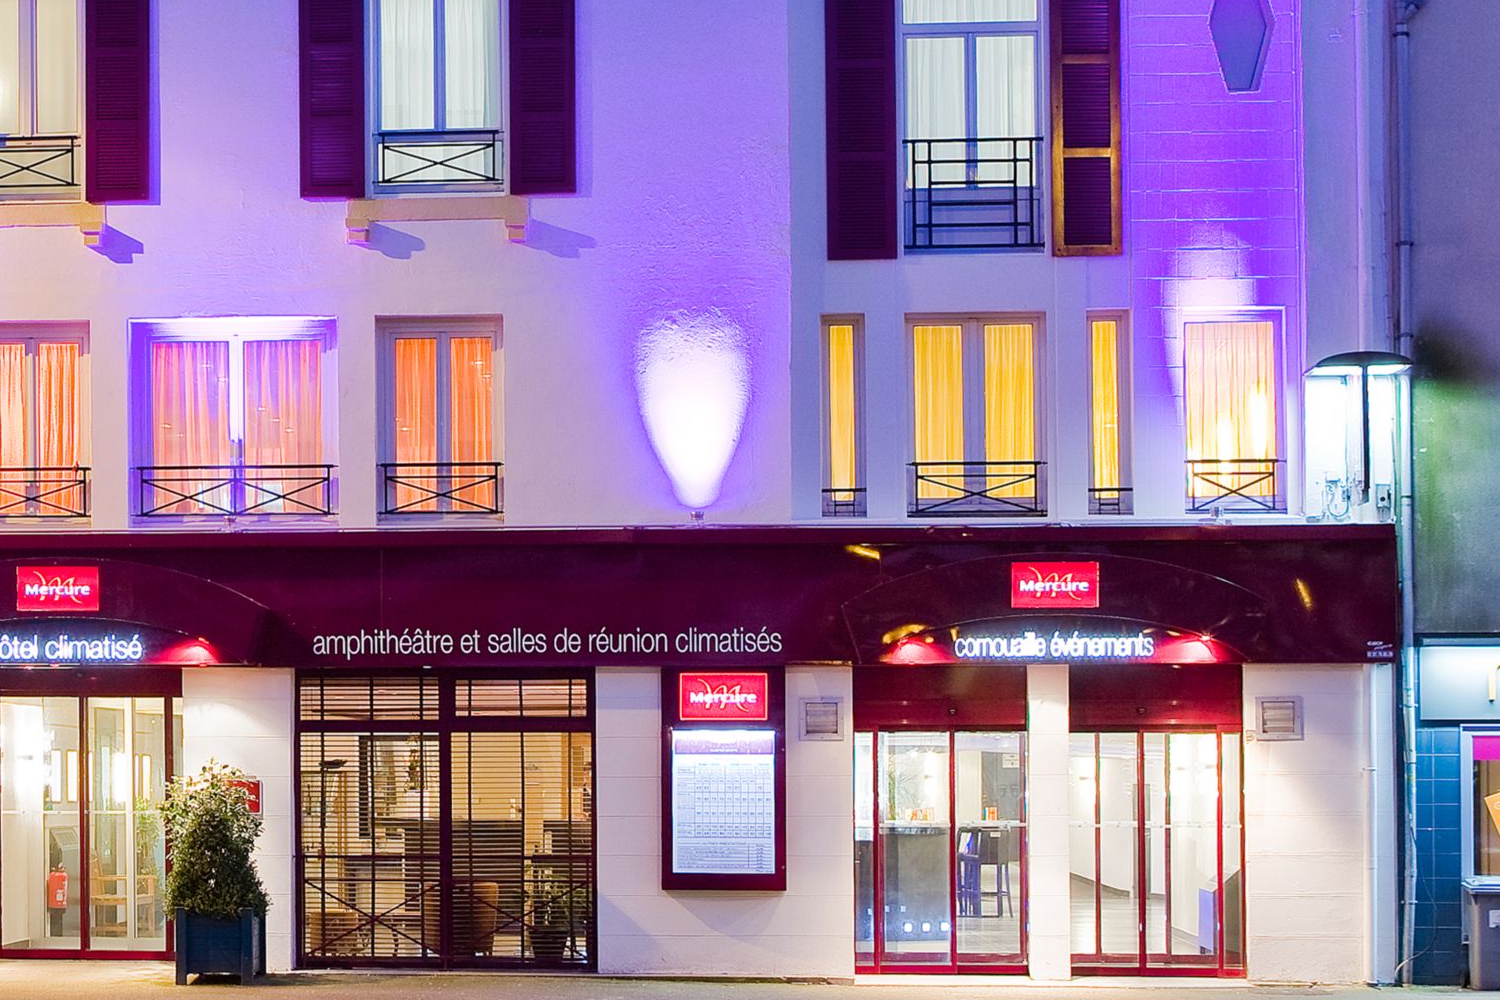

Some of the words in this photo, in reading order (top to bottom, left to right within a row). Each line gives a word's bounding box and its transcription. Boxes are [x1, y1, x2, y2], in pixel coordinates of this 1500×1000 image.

[24, 583, 91, 596] Mercure
[1019, 579, 1090, 593] Mercure
[44, 633, 144, 660] climatisé
[312, 627, 454, 661] amphithéâtre
[460, 630, 481, 654] et
[487, 627, 547, 654] salles
[553, 627, 582, 653] de
[588, 627, 668, 653] réunion
[674, 625, 783, 653] climatisés
[1050, 630, 1155, 658] événements
[689, 691, 757, 704] Mercure
